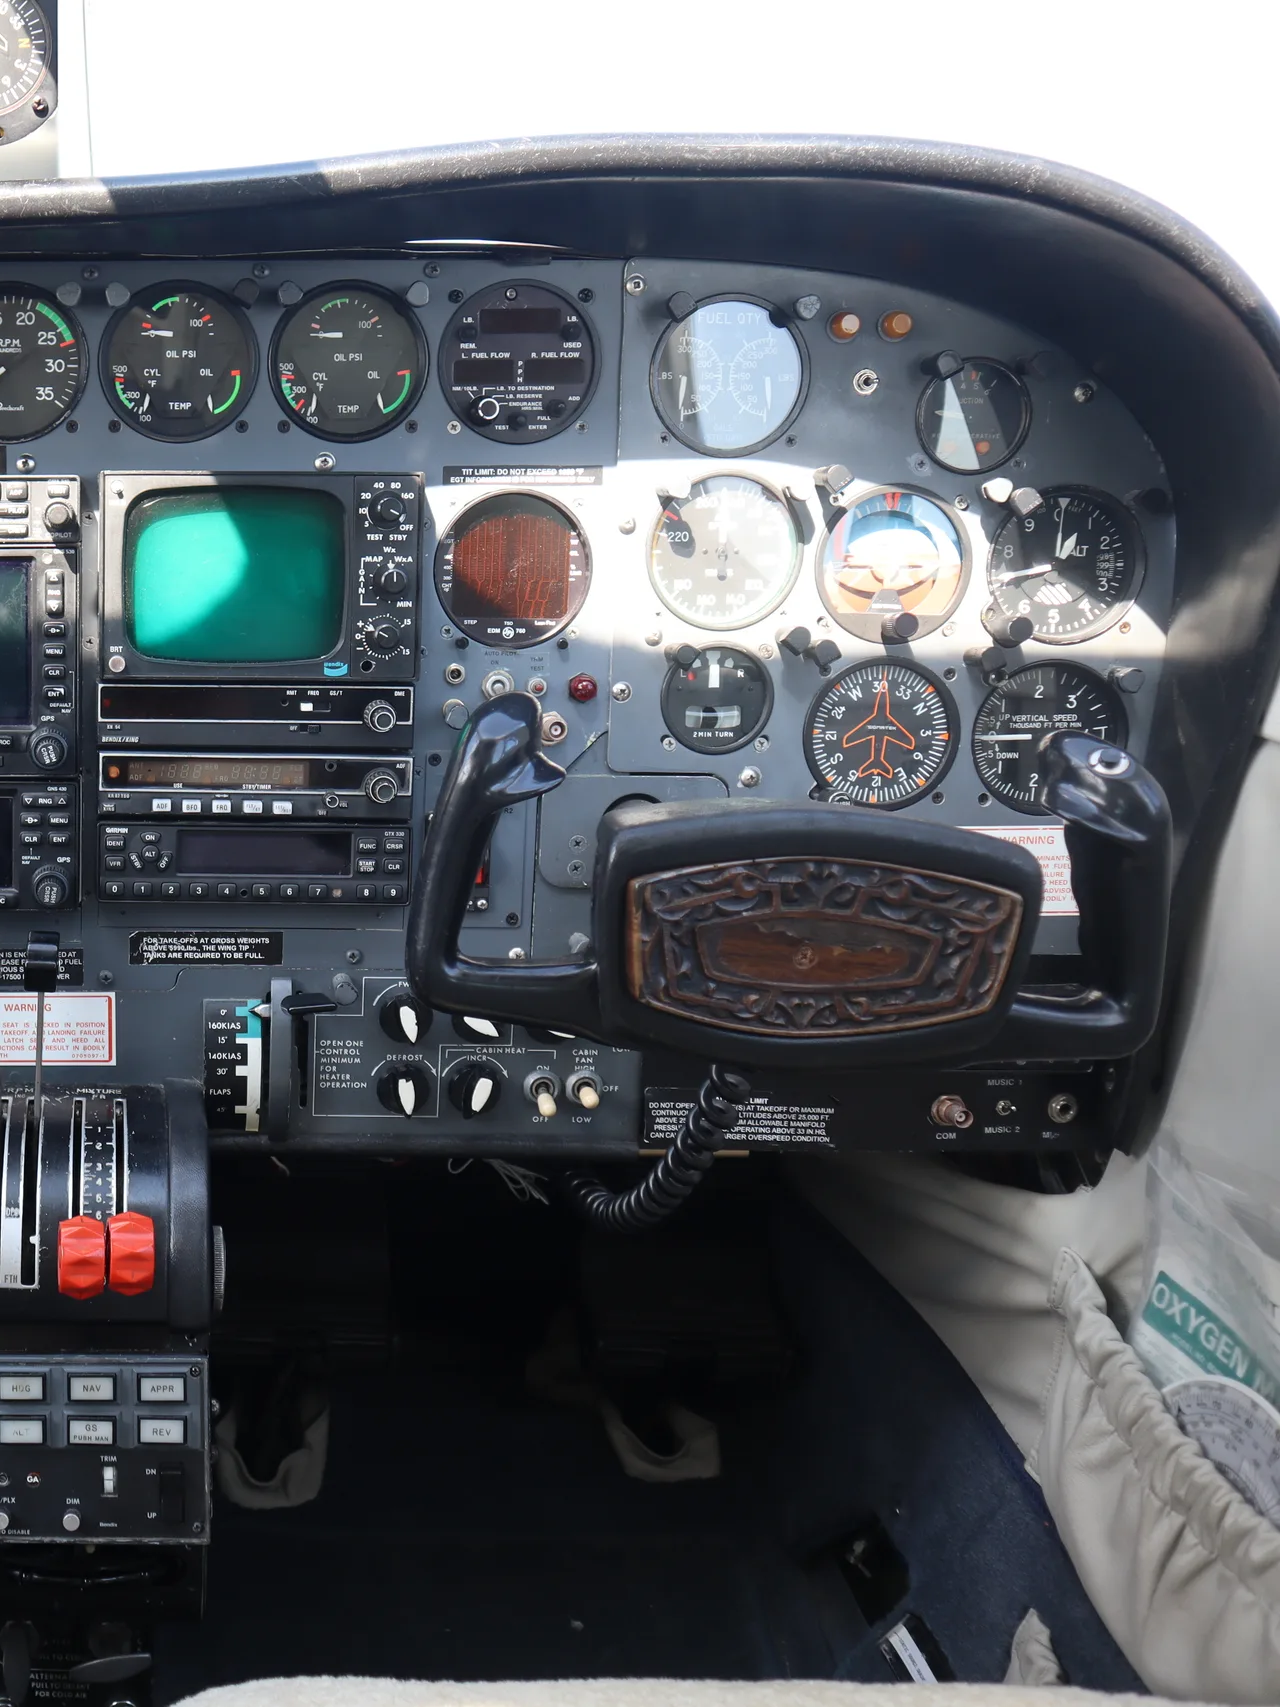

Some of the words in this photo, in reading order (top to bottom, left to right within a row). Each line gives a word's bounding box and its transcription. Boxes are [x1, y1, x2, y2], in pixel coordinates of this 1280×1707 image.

[16, 313, 35, 325] 20
[189, 319, 203, 327] 100
[37, 333, 57, 344] 25
[182, 350, 196, 358] PSI
[349, 353, 362, 361] PSI
[45, 360, 65, 372] 30
[112, 365, 127, 373] 500
[144, 369, 161, 377] CYL
[200, 368, 213, 376] OIL
[367, 371, 380, 379] OIL
[312, 373, 328, 381] CYL
[36, 388, 54, 400] 35
[169, 402, 192, 410] TEMP
[337, 405, 359, 413] TEMP
[668, 532, 689, 542] 220
[1012, 714, 1049, 722] VERTICAL
[4, 1003, 52, 1012] WARNIG
[208, 1022, 241, 1030] 160KIAS
[208, 1052, 241, 1060] 140KIAS
[209, 1088, 231, 1096] FLAPS
[935, 1132, 956, 1140] COM
[1152, 1283, 1250, 1378] OXYGEN
[150, 1385, 174, 1393] APPR
[85, 1424, 98, 1432] GS
[152, 1428, 171, 1436] REV
